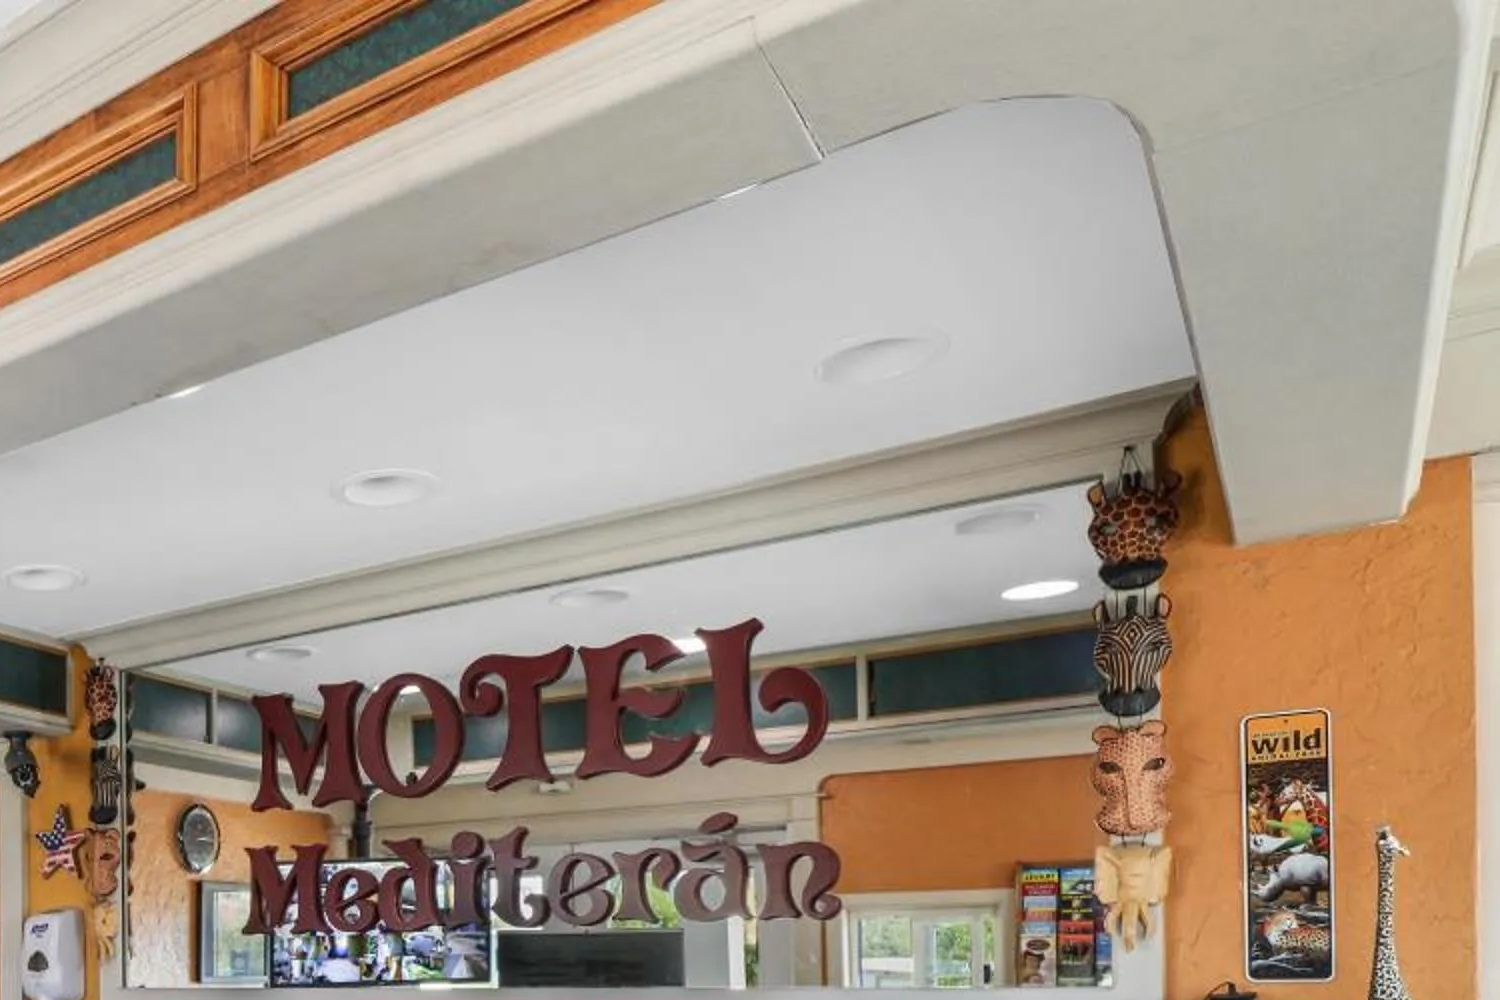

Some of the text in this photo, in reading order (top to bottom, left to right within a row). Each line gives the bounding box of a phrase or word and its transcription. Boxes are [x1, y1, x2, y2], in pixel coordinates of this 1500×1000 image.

[251, 617, 830, 812] MOTEL
[1251, 727, 1321, 755] wild
[241, 812, 842, 935] Mediterán
